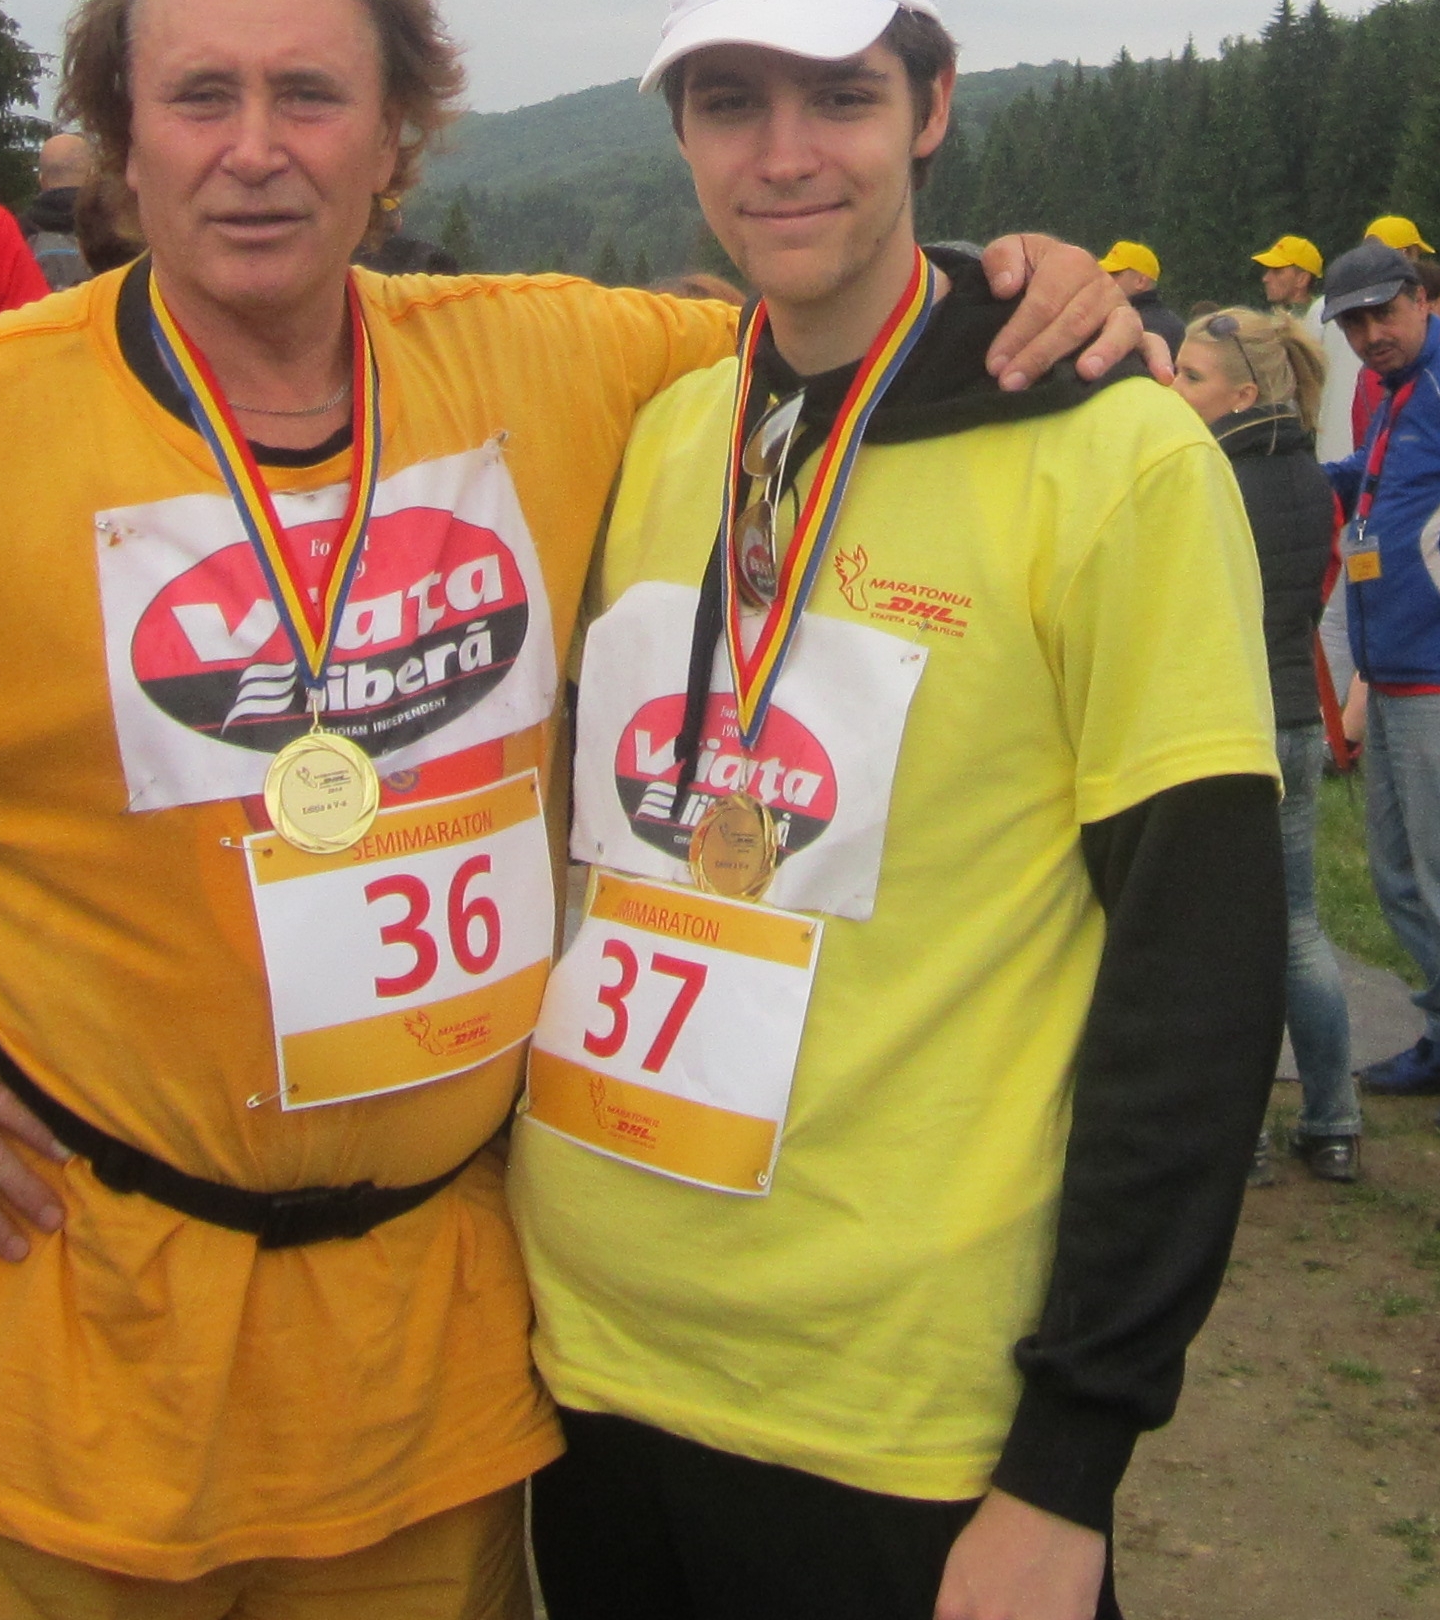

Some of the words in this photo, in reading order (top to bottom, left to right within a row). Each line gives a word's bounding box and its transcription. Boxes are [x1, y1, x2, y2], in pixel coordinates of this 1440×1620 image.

[869, 578, 973, 609] MARATONUL
[887, 596, 954, 624] DHL
[325, 724, 368, 737] TIDIAN
[372, 697, 447, 733] INDEPENDENT
[352, 809, 493, 861] SEMIMARATON
[363, 853, 502, 999] 36
[582, 938, 709, 1075] 37
